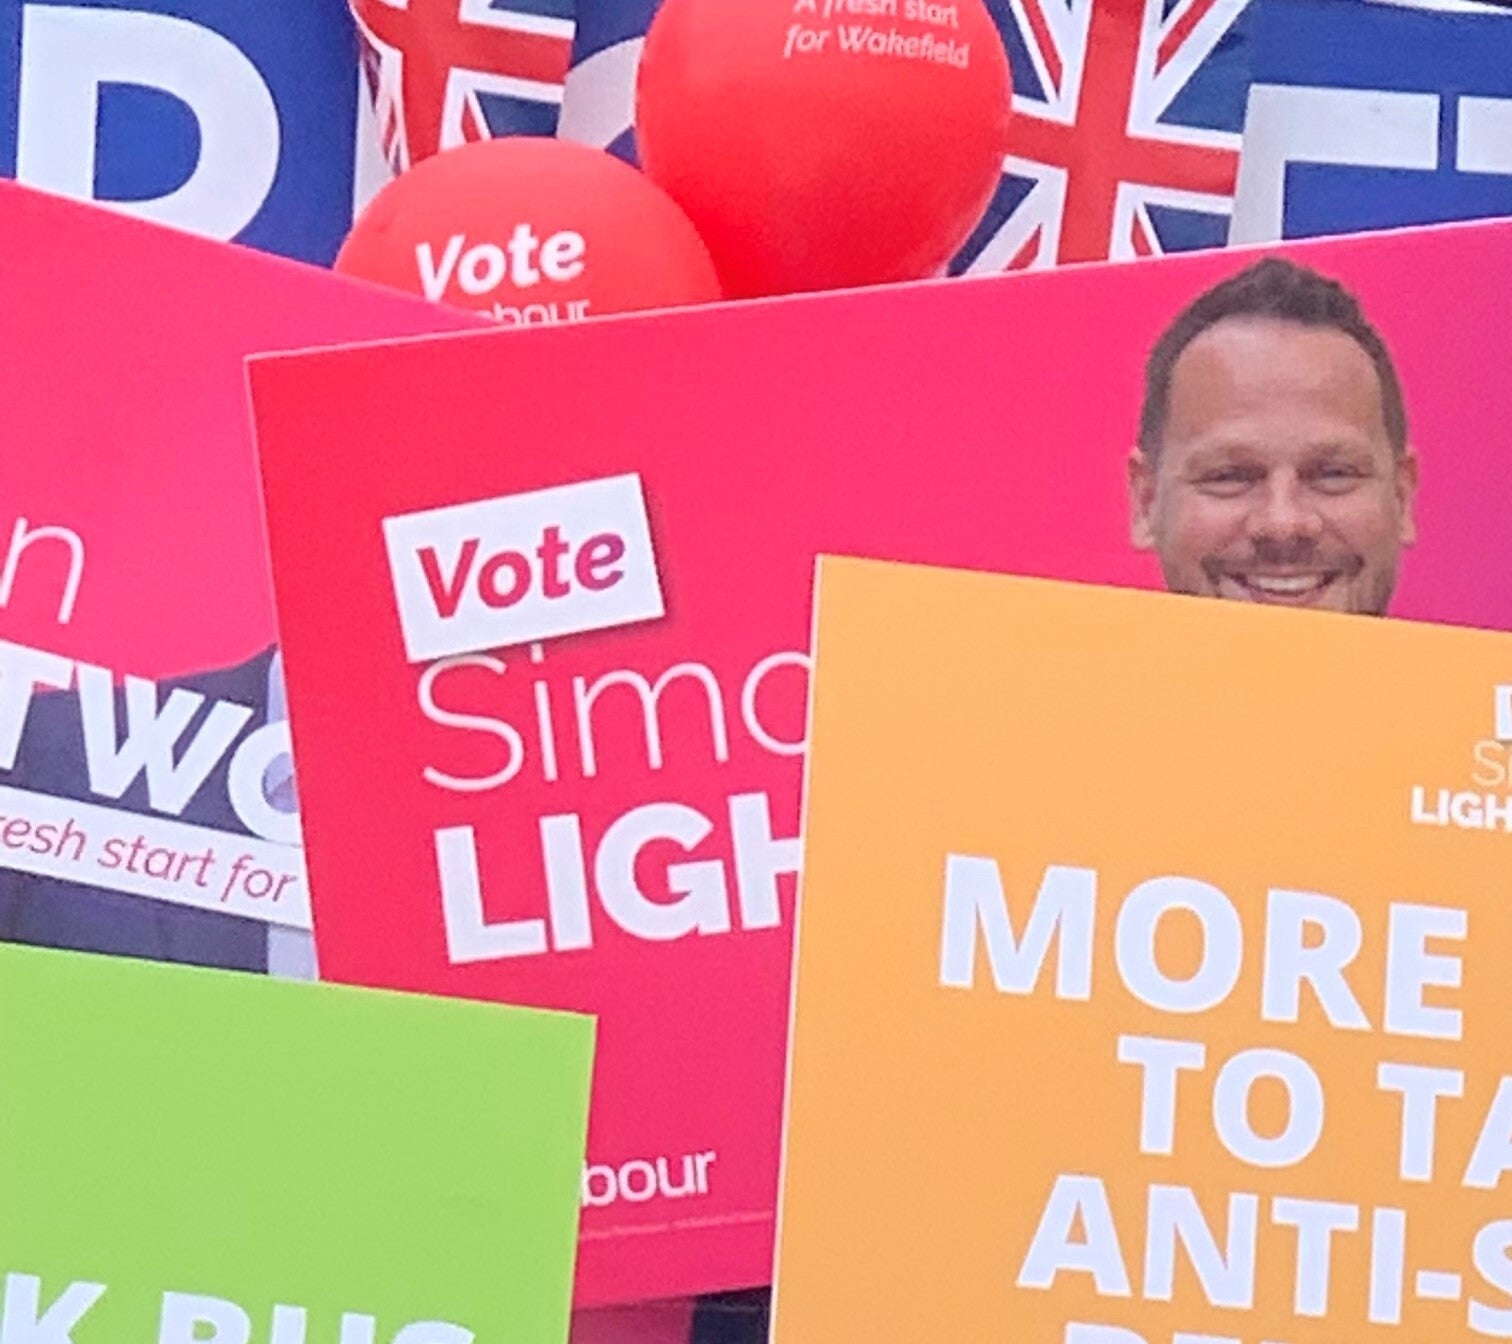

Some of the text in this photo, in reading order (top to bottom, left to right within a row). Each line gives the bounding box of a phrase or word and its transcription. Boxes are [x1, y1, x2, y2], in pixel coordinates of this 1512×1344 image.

[783, 23, 969, 69] for Wakefield
[905, 0, 959, 28] start
[415, 223, 586, 303] Vote
[415, 525, 627, 621] Vote
[0, 813, 299, 903] esh start for
[940, 851, 1468, 1041] MORE
[1117, 1034, 1325, 1168] TO
